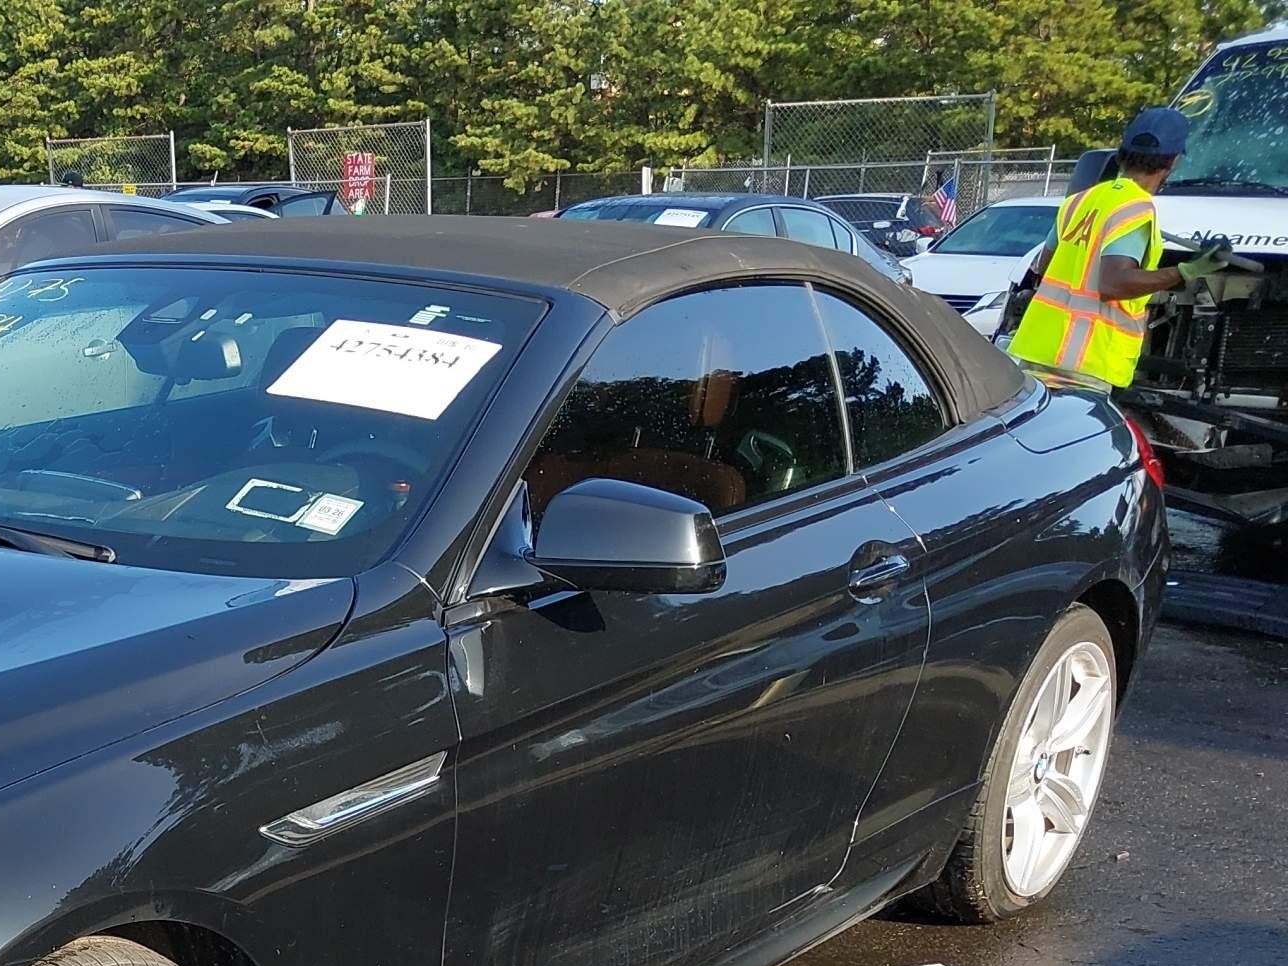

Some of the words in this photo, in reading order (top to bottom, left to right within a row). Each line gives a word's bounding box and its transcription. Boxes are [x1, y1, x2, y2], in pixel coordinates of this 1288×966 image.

[346, 153, 372, 164] STATE
[348, 165, 371, 176] FARM
[348, 188, 370, 199] AREA
[329, 339, 460, 368] 42754384
